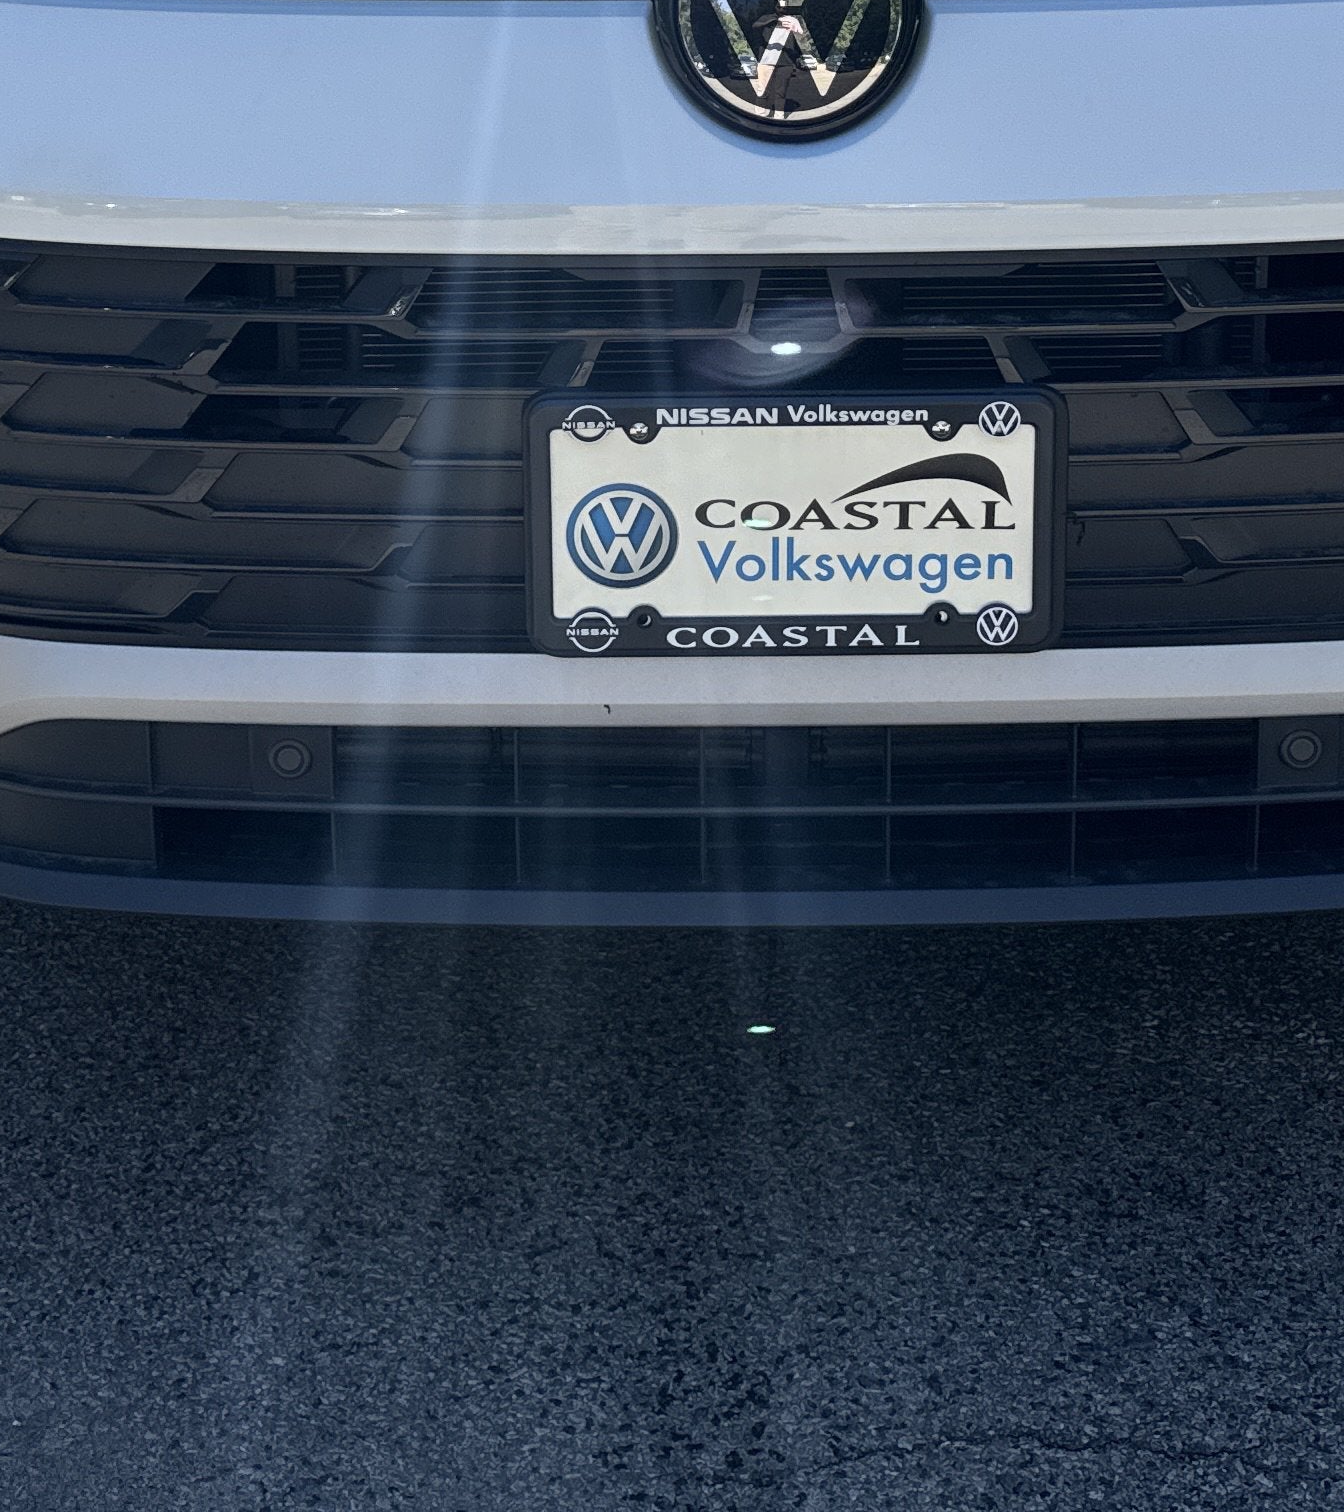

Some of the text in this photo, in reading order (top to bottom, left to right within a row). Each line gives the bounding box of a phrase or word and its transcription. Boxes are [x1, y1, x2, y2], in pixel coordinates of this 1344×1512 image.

[561, 420, 616, 430] NISSAN
[656, 404, 929, 426] NISSAN Volkswagen
[695, 498, 1016, 531] COASTAL
[697, 537, 1013, 593] Volkswagen
[566, 627, 619, 637] NISSAN
[666, 625, 920, 648] COASTAL
